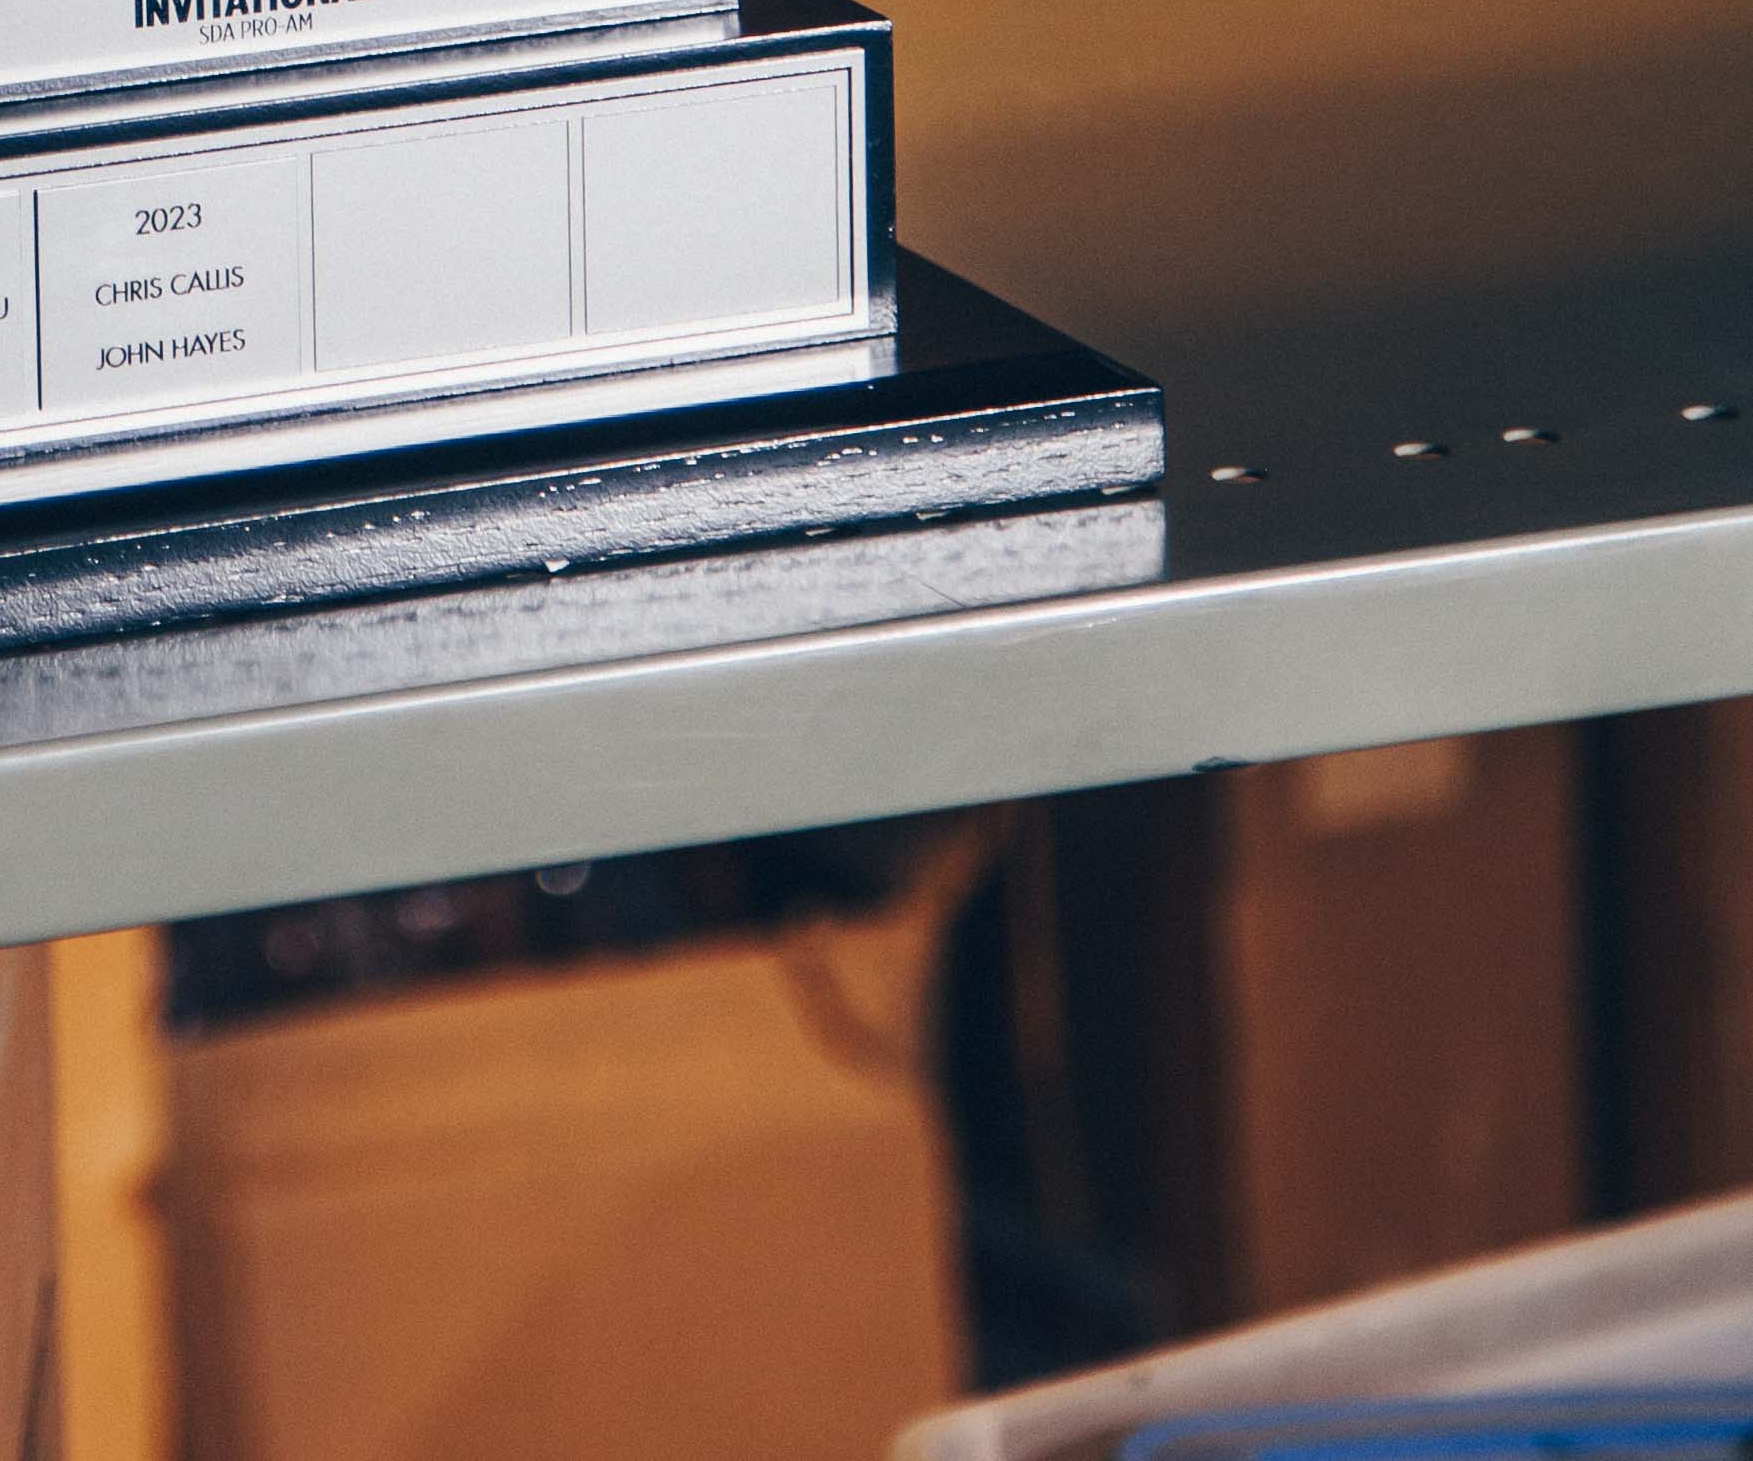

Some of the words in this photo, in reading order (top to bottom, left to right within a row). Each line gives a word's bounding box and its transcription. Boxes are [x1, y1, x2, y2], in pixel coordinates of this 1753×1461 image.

[199, 24, 235, 45] SDA
[240, 12, 313, 40] PRO-AM
[134, 202, 202, 236] 2023
[95, 277, 163, 307] CHRIS
[169, 265, 245, 296] CALLIS
[96, 339, 164, 371] JOHN
[171, 328, 246, 359] HAYES
